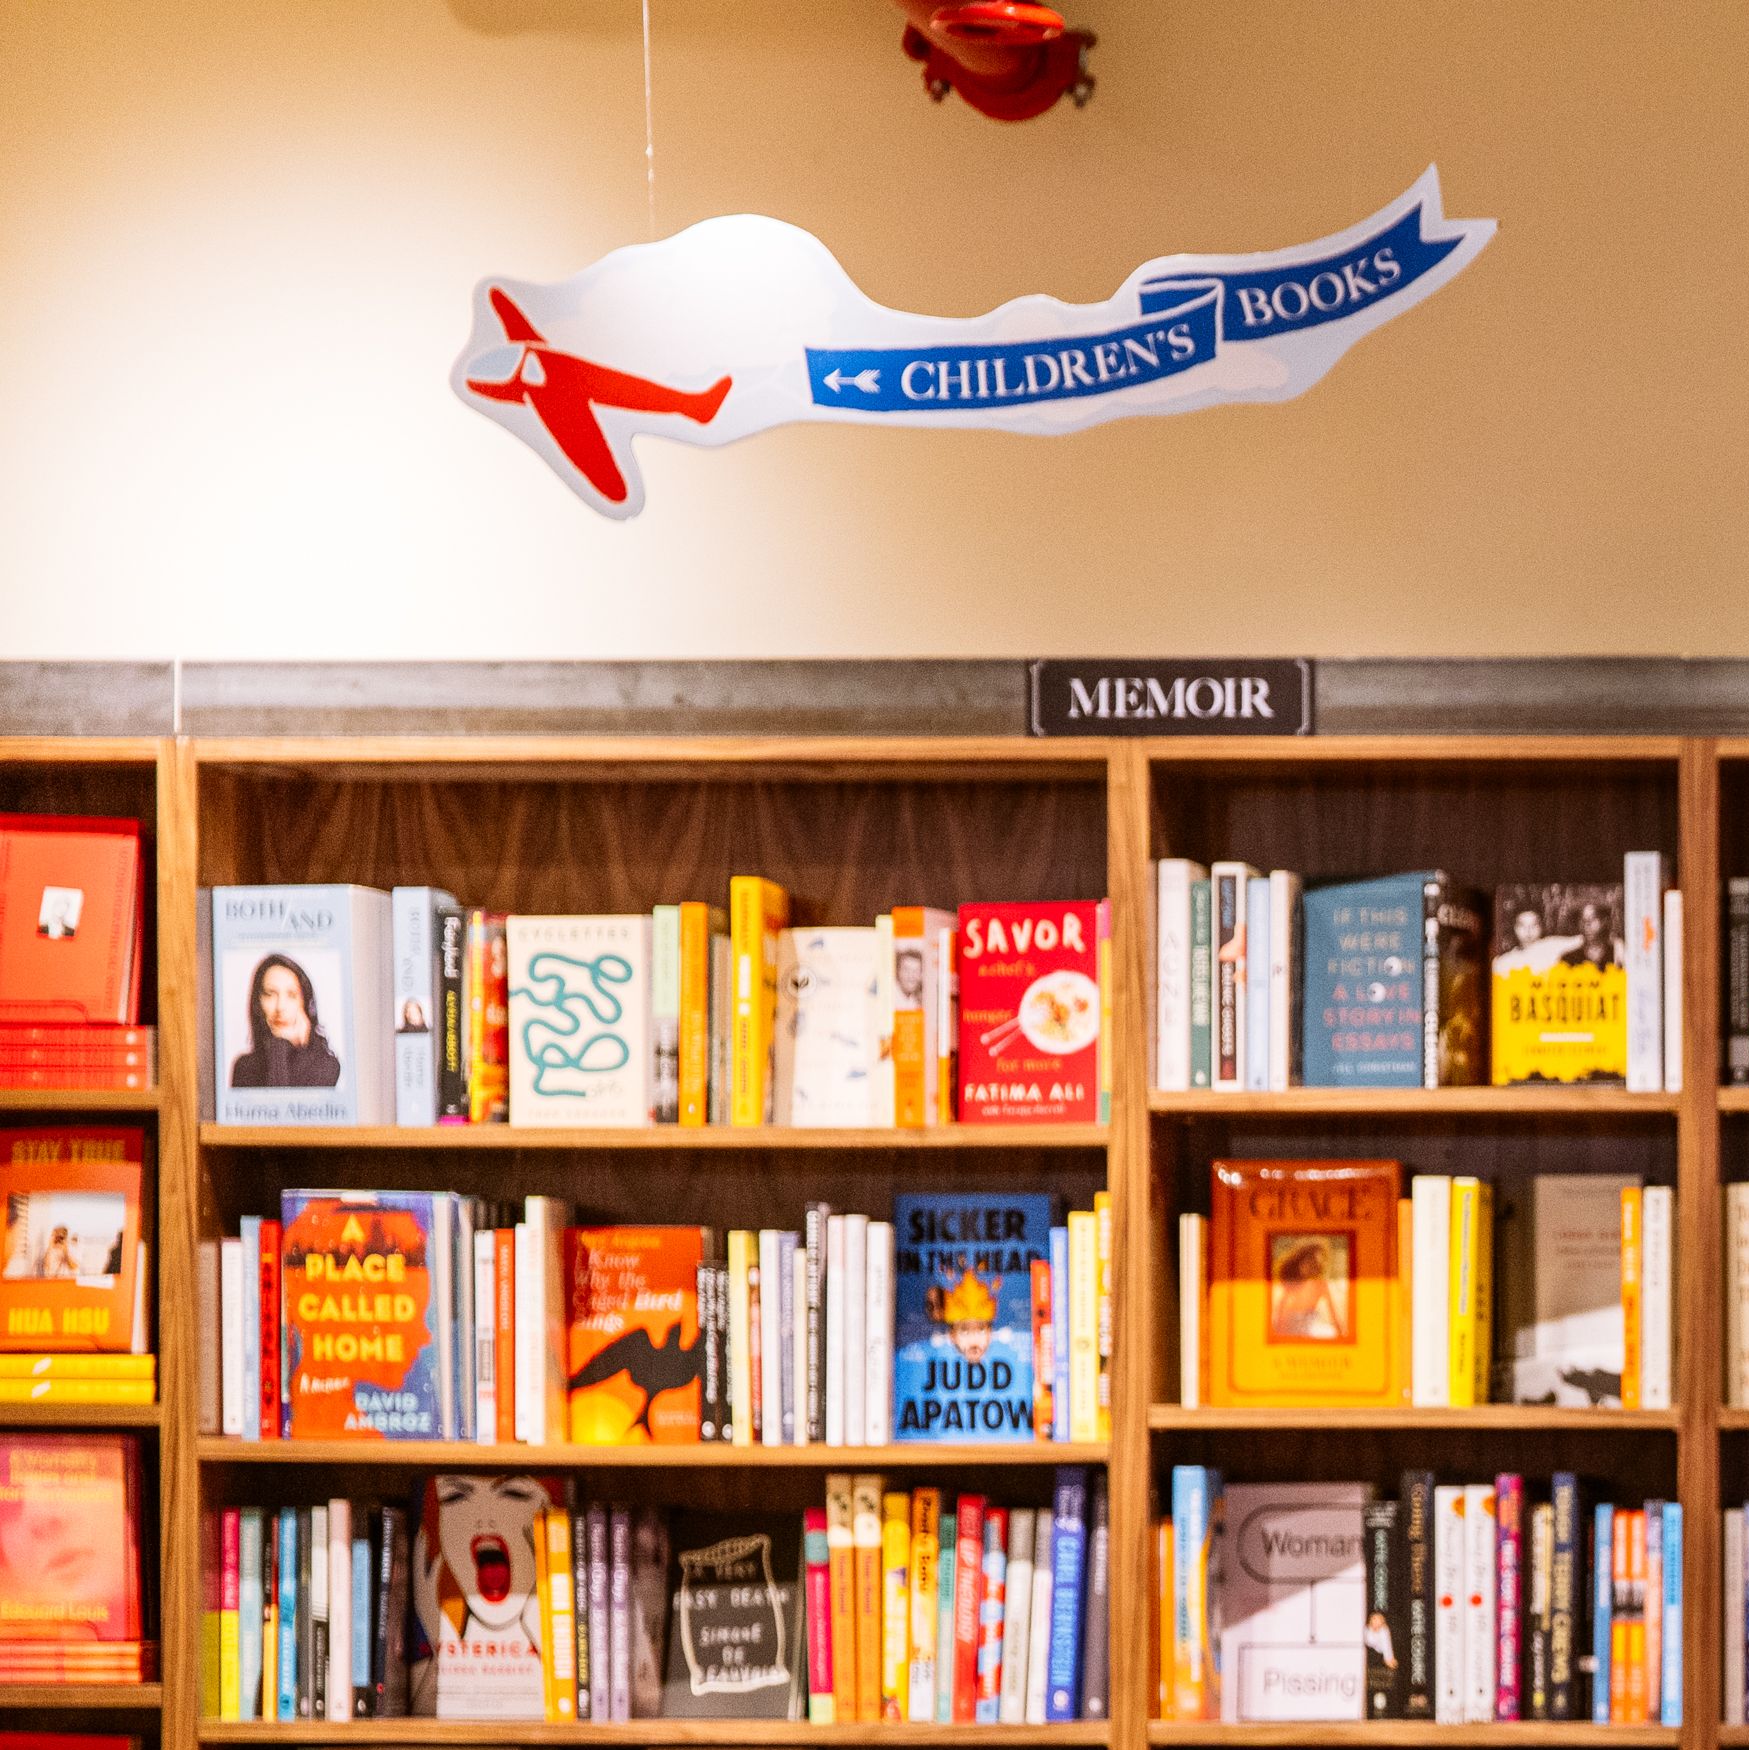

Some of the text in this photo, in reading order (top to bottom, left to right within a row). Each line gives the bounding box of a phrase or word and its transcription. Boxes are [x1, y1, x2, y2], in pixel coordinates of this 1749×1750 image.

[900, 247, 1401, 400] CHILDREN'S BOOKS
[1068, 677, 1274, 718] MEMOIR
[962, 913, 1086, 958] SAVOR
[909, 1209, 1026, 1243] SICKER
[305, 1254, 406, 1282] PLACE
[298, 1294, 416, 1322] CALLED
[313, 1334, 404, 1361] HOME
[923, 1361, 1012, 1391] JUDD
[900, 1401, 1033, 1432] APATOW
